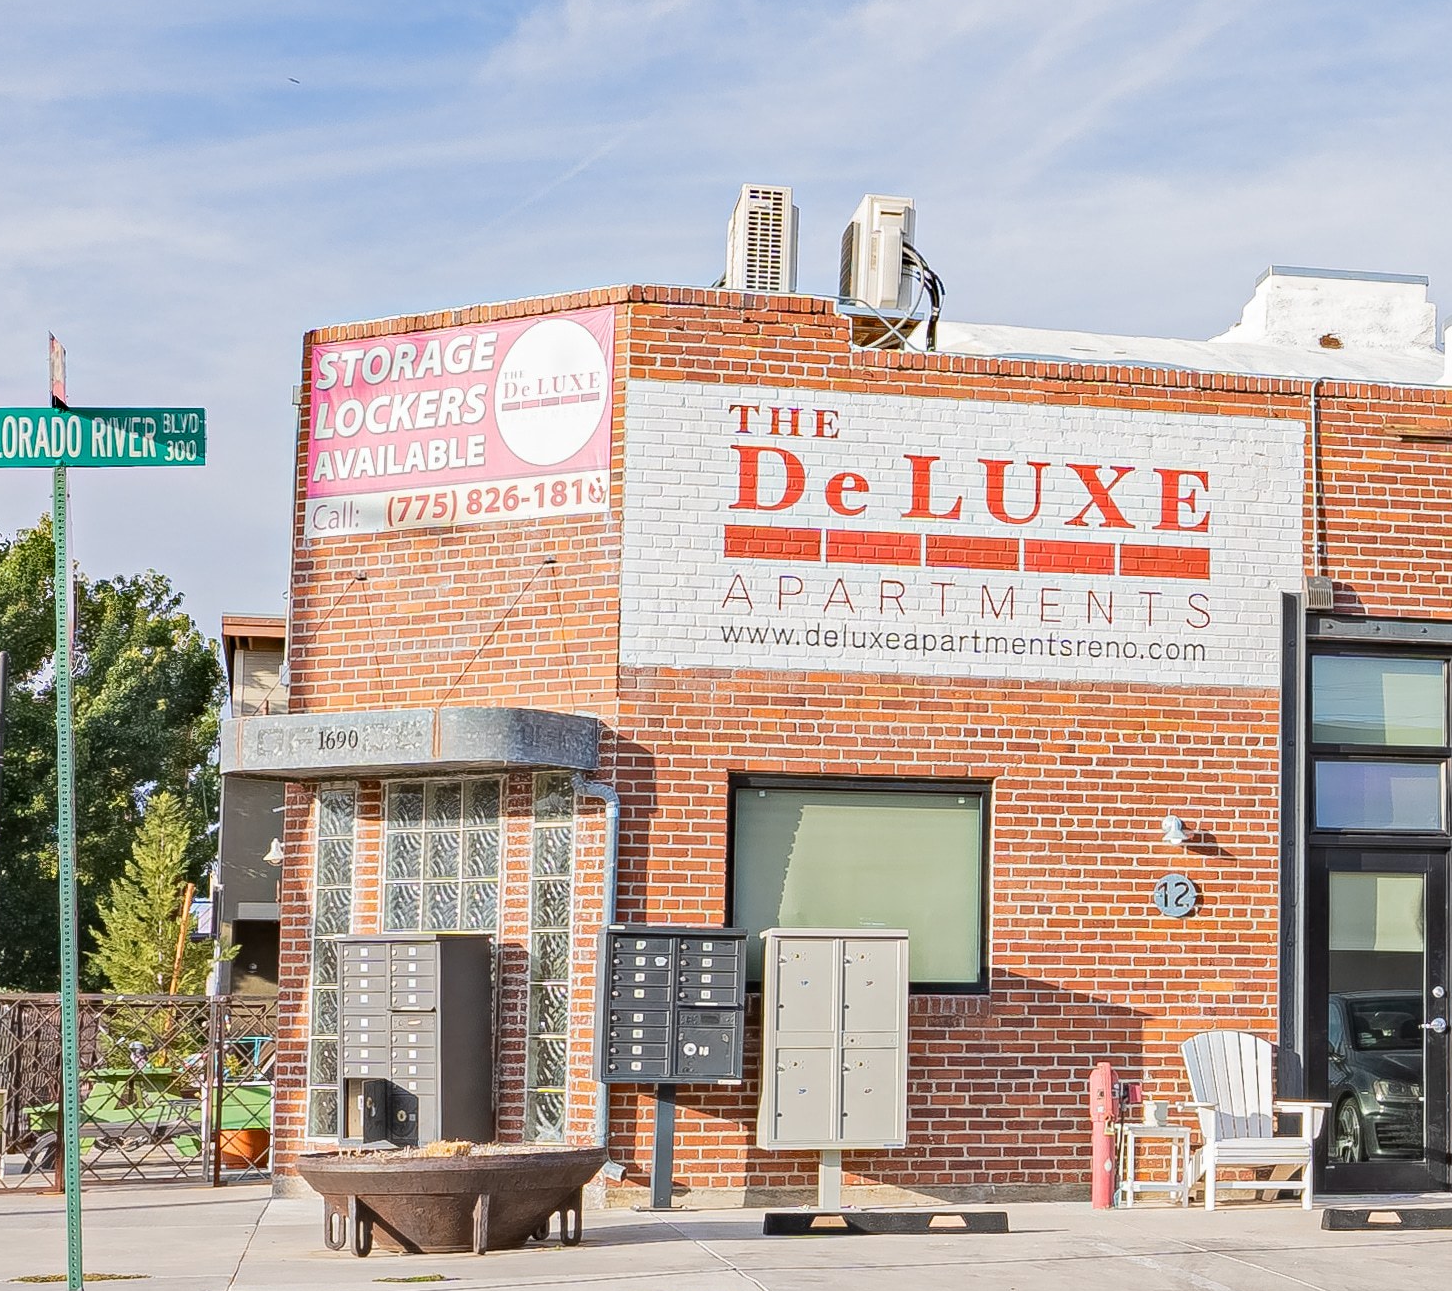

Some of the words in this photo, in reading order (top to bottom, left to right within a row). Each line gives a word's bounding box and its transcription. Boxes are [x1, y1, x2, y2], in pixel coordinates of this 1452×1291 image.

[315, 331, 499, 390] STORAGE
[504, 370, 524, 380] THE
[314, 384, 487, 440] LOCKERS
[729, 404, 841, 439] THE
[91, 416, 157, 458] RIVER
[162, 412, 199, 434] BLVD
[164, 441, 197, 462] 300
[312, 435, 486, 482] AVAILABLE
[312, 501, 360, 531] Call:
[387, 490, 457, 527] (775)
[722, 572, 1210, 629] APARTMENTS
[720, 621, 1206, 662] www.deluxeapartmentsreno.com
[318, 730, 358, 751] 1690
[1157, 881, 1190, 908] 12
